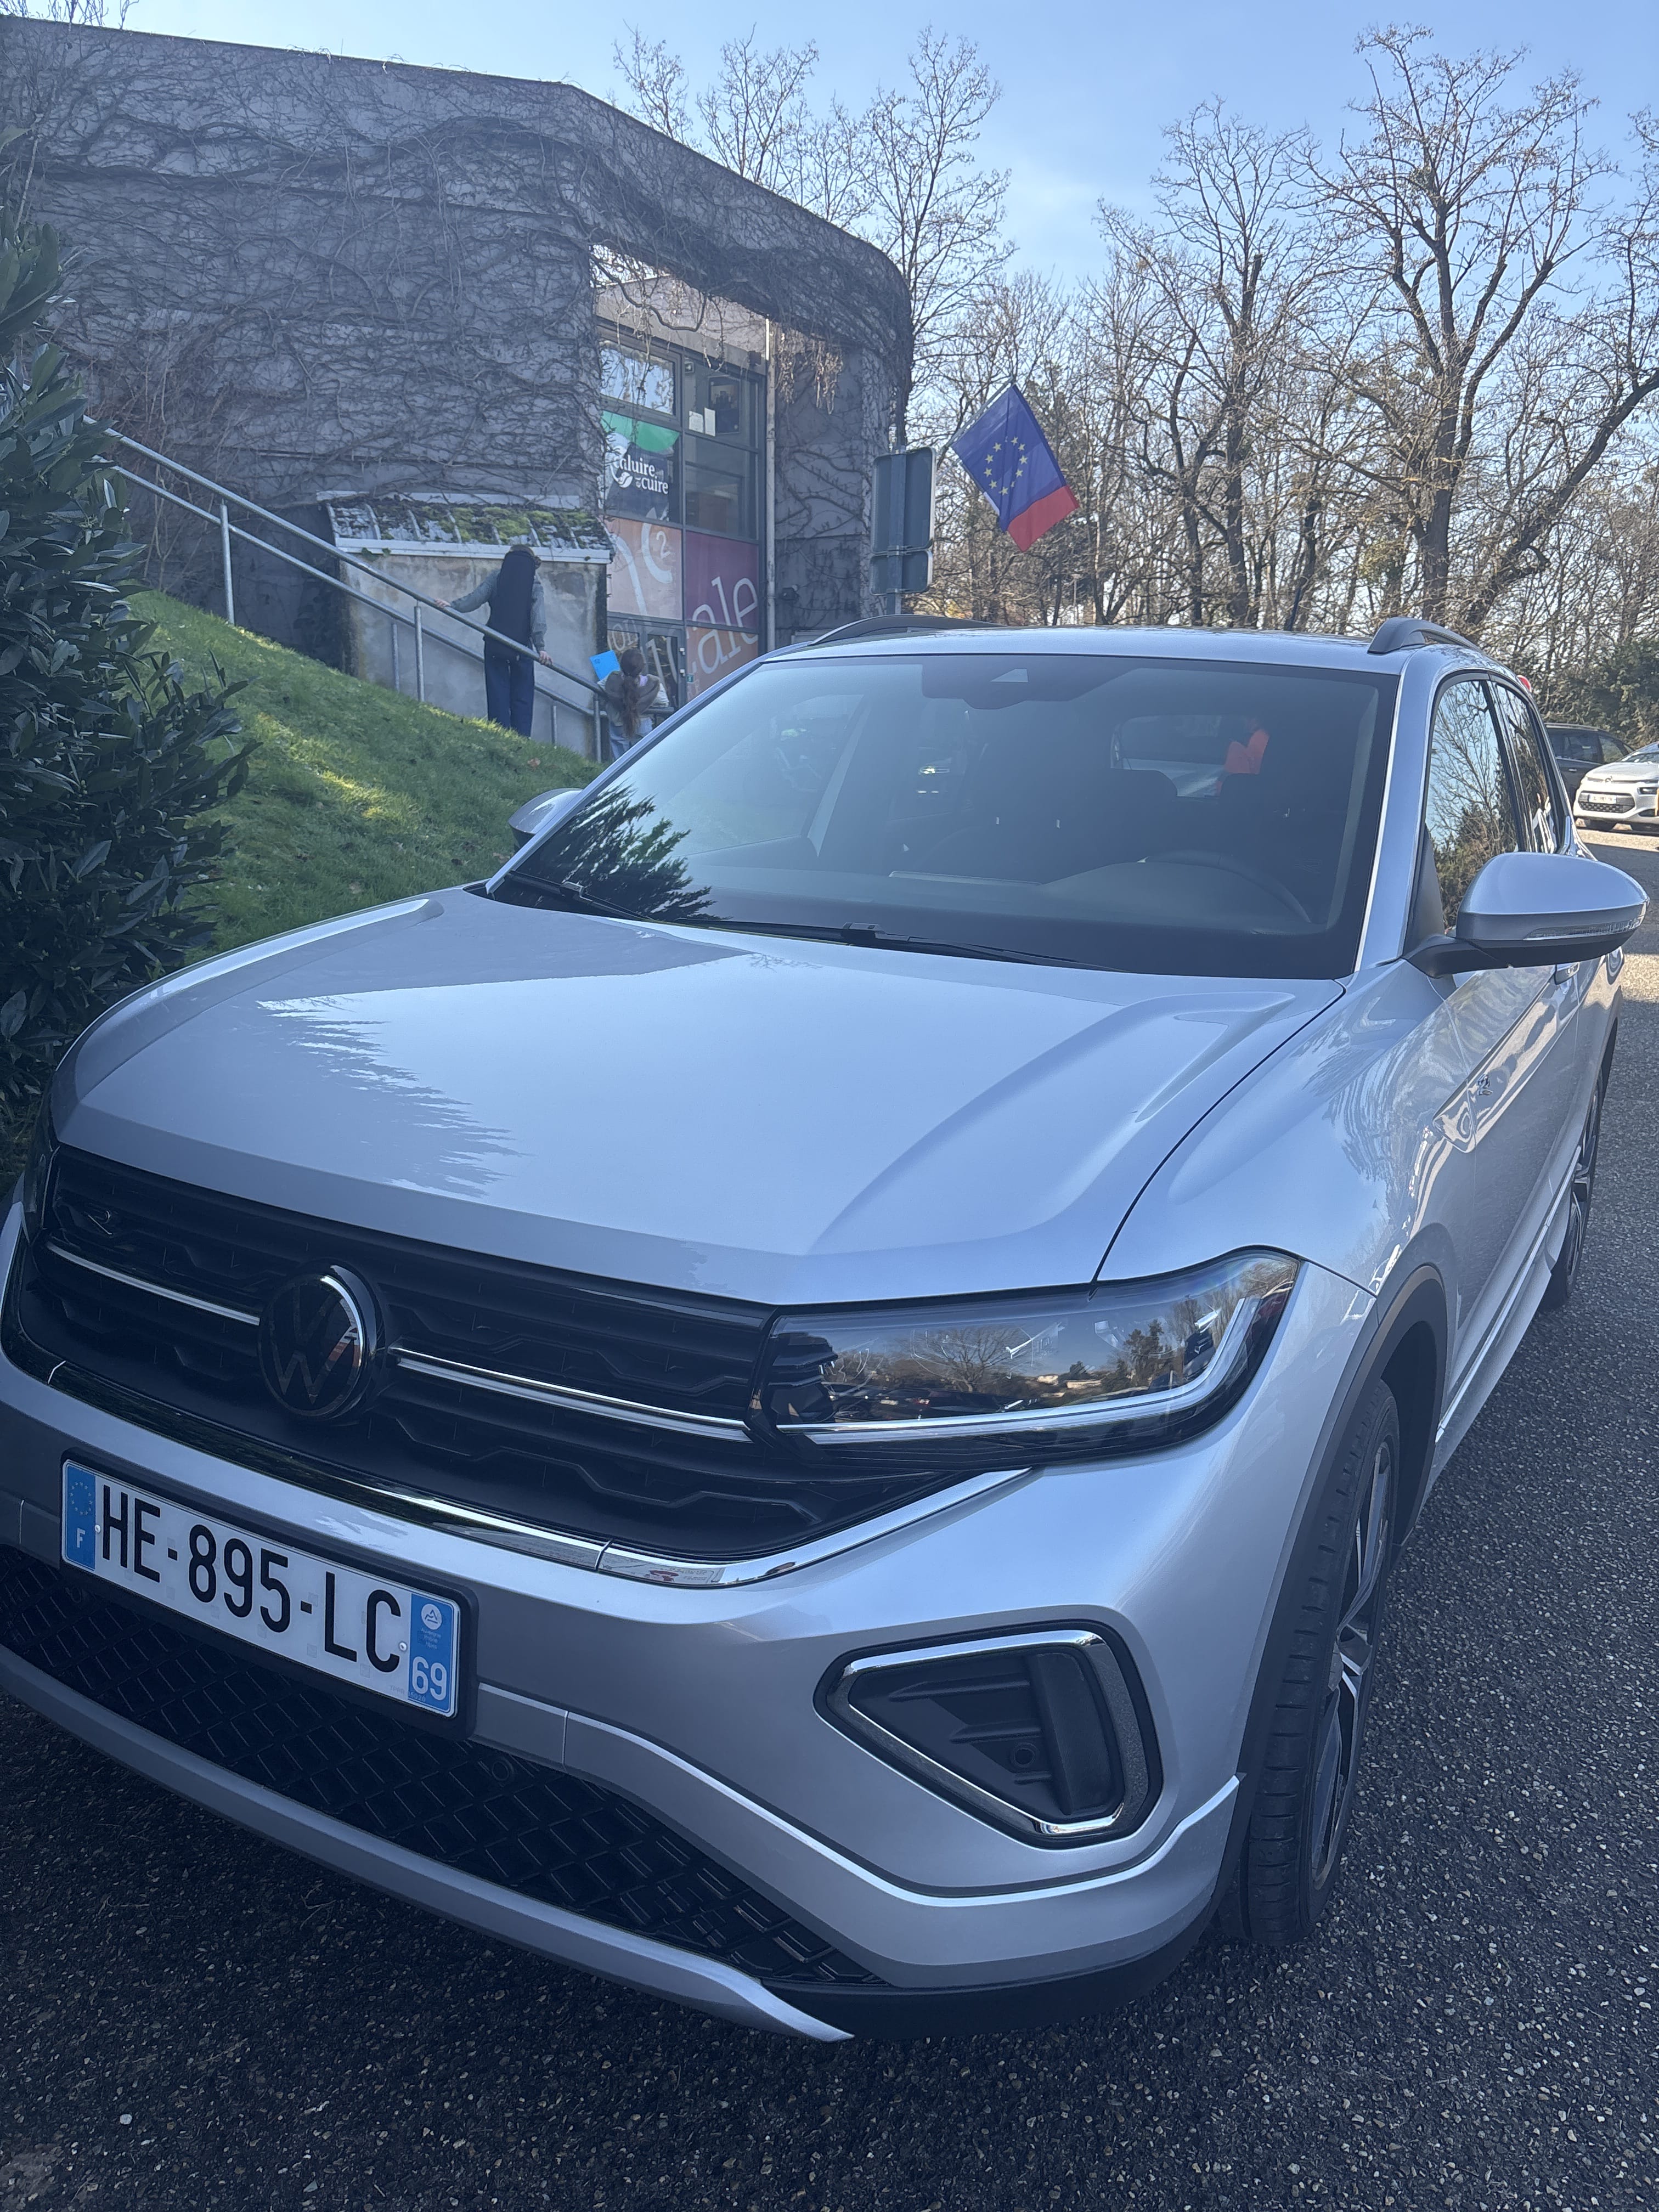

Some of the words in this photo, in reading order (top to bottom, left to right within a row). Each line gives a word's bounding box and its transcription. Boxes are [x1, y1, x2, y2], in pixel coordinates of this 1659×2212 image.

[76, 1528, 86, 1548] F
[103, 1484, 401, 1673] HE-895-LC
[412, 1656, 447, 1701] 69
